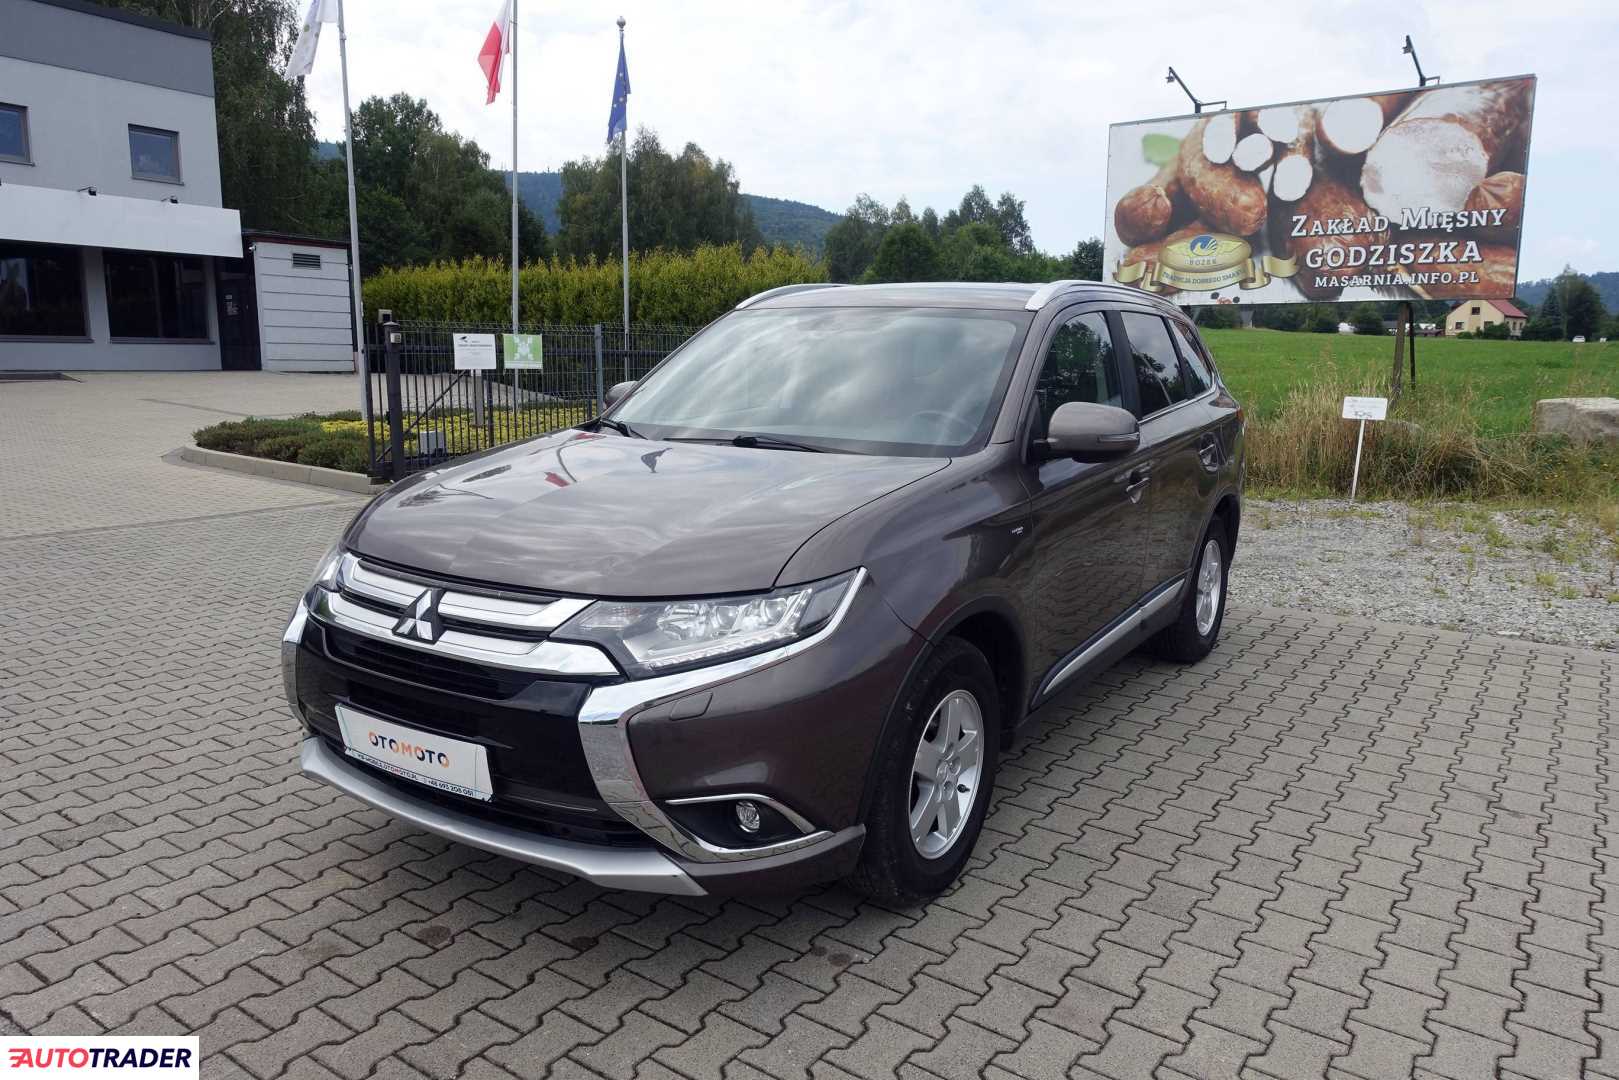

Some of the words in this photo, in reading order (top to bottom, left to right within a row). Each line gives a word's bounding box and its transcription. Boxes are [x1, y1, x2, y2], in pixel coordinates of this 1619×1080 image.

[1291, 214, 1389, 237] ZAKŁAD
[1400, 207, 1507, 232] MIĘSNY
[1305, 240, 1483, 269] GODZISZKA
[1314, 271, 1481, 288] MASARNIA.INFO.PL
[368, 731, 450, 769] OTOMOTO
